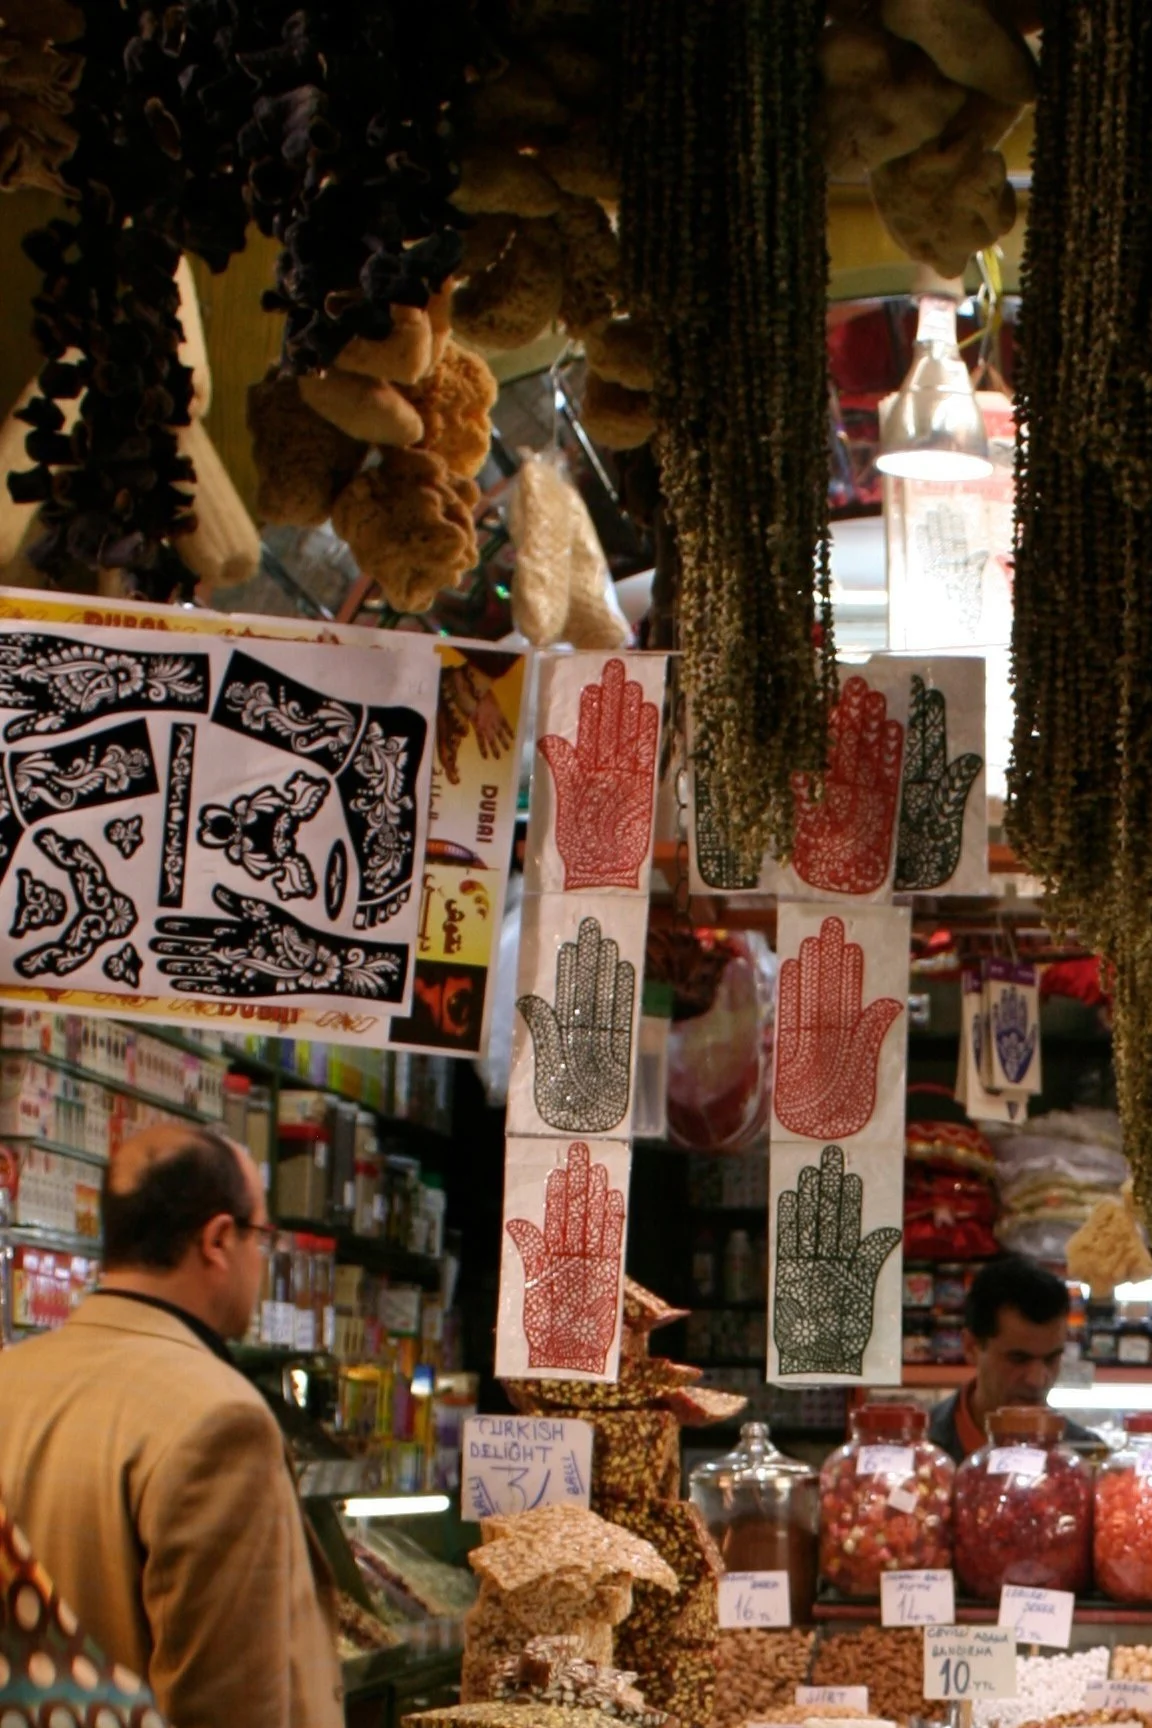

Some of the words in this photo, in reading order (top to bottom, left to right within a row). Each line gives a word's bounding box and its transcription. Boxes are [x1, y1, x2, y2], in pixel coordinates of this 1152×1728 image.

[476, 783, 499, 844] DUBAI
[475, 1419, 564, 1441] TURKISH
[939, 1657, 970, 1697] 10
